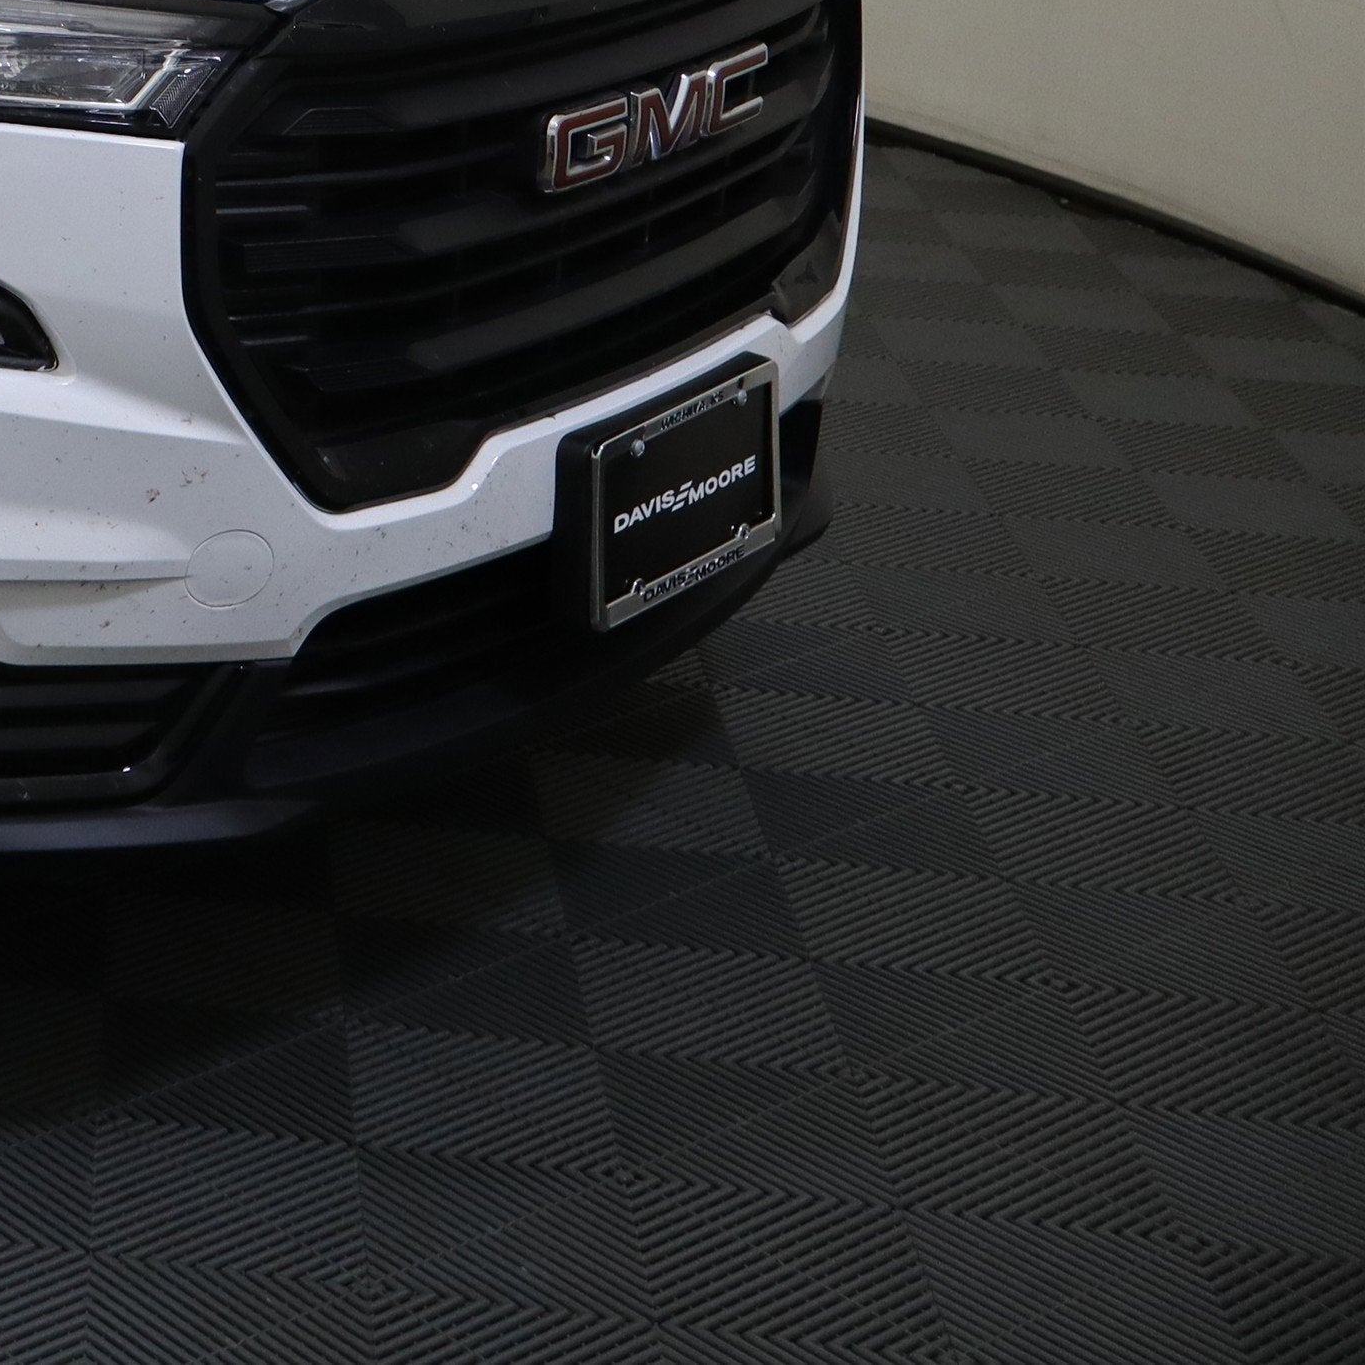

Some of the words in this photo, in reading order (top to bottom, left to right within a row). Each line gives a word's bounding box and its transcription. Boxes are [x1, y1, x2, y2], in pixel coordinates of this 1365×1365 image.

[544, 42, 768, 193] GMC
[614, 489, 675, 534] DAVIS
[688, 454, 757, 506] MOORE
[643, 574, 686, 604] DAVIS
[695, 545, 746, 583] MOORE
